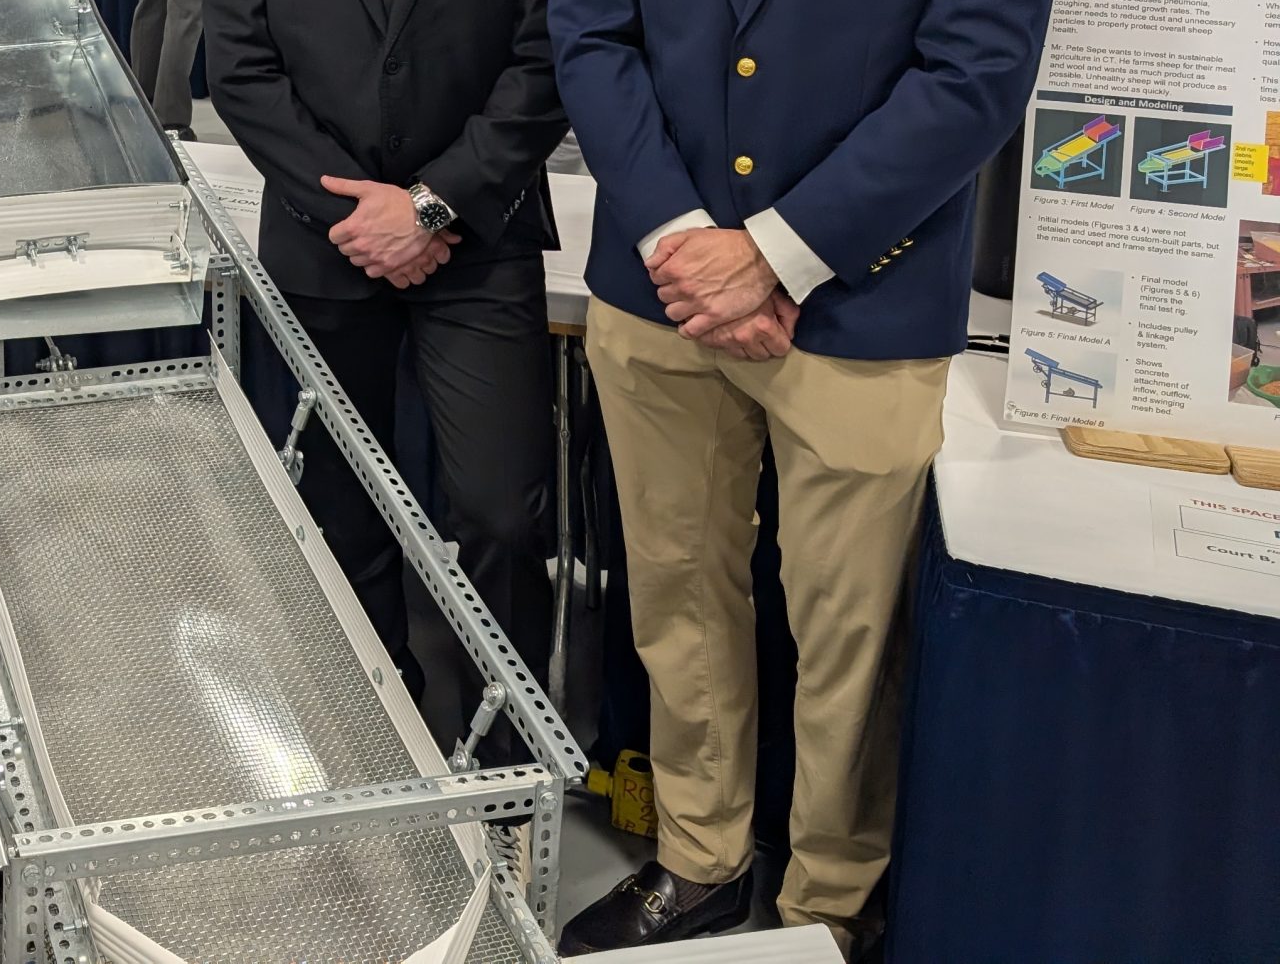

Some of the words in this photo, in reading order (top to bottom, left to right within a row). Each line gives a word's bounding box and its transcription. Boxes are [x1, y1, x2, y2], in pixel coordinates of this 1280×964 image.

[1084, 95, 1116, 106] Design
[1118, 98, 1136, 107] and
[1139, 99, 1184, 112] Modeling
[1034, 195, 1056, 206] Figure
[1059, 198, 1068, 206] 3:
[1070, 199, 1088, 208] First
[1090, 200, 1114, 210] Model
[1130, 206, 1154, 216] Figure
[1157, 208, 1166, 216] 4:
[1168, 209, 1198, 219] Second
[1200, 211, 1226, 221] Model
[1021, 328, 1046, 339] Figure
[1048, 330, 1055, 338] 5:
[1057, 331, 1077, 342] Final
[1079, 333, 1102, 345] Model
[1104, 337, 1111, 345] A
[1014, 408, 1039, 420] Figure
[1042, 411, 1049, 420] 6:
[1050, 412, 1070, 423] Final
[1072, 415, 1096, 426] Model
[1190, 499, 1227, 510] THIS
[1231, 507, 1280, 520] SPACE
[1207, 545, 1254, 559] Court
[1260, 555, 1275, 564] B,
